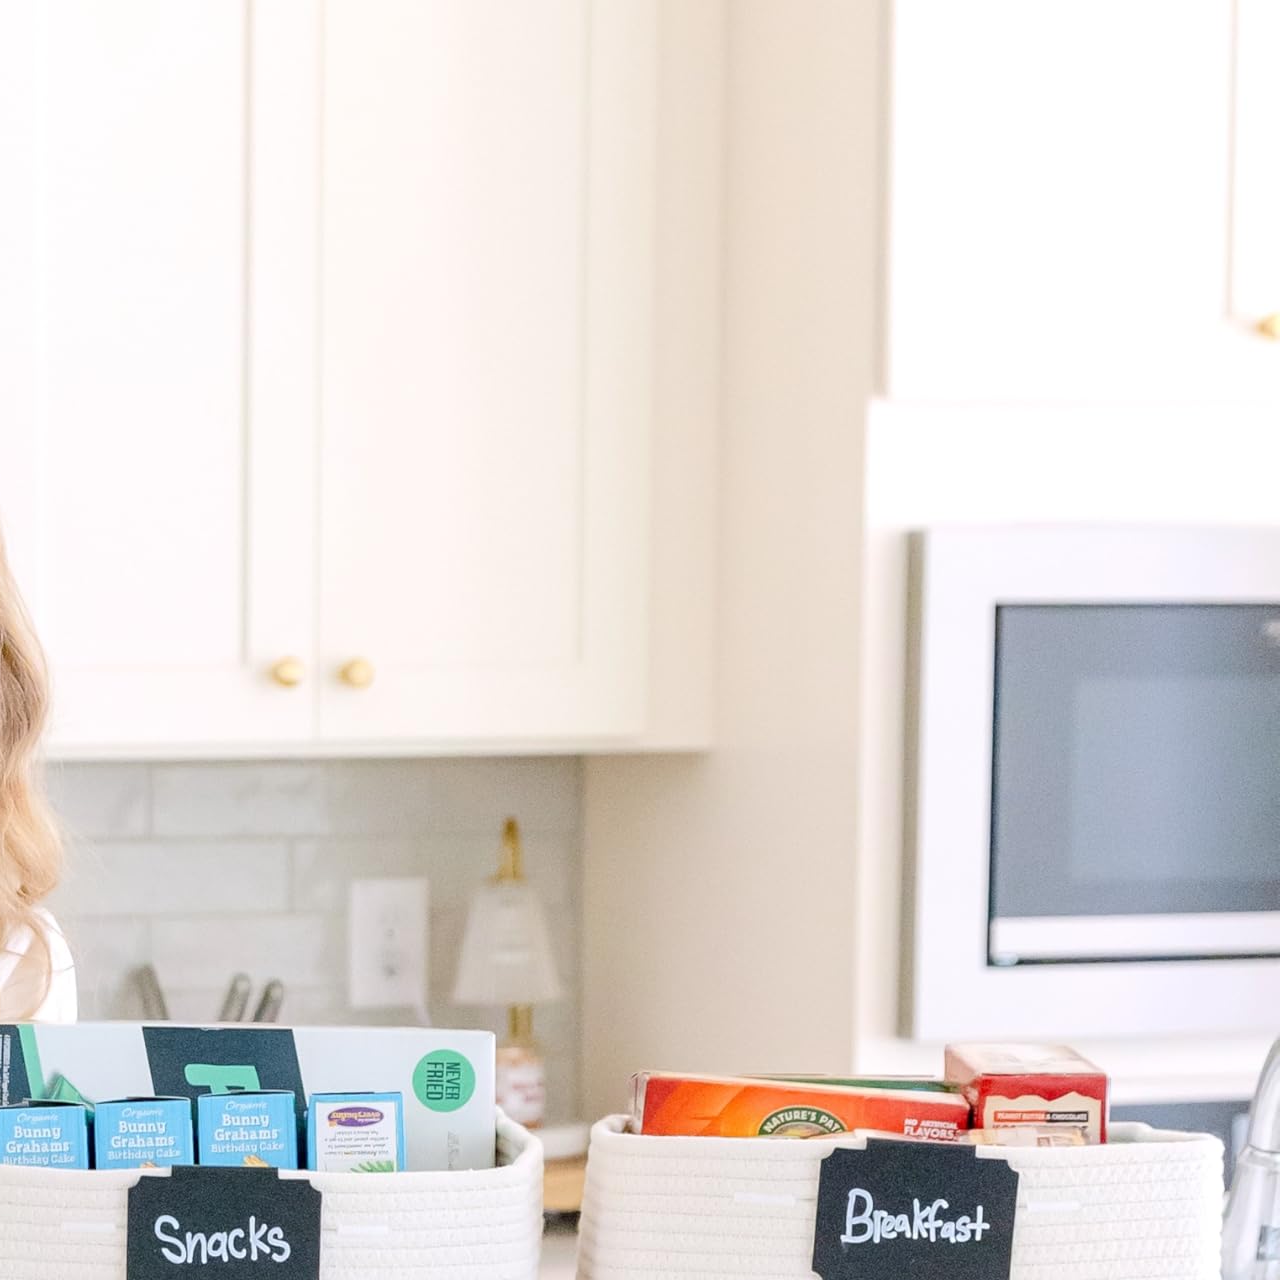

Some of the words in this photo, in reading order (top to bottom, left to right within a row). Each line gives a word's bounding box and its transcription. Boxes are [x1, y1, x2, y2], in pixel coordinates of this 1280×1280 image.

[426, 1062, 444, 1101] FRIED
[445, 1062, 461, 1100] NEVER
[225, 1101, 267, 1111] Organic
[222, 1114, 269, 1127] Bunny
[763, 1110, 816, 1133] NATURE'S
[14, 1126, 61, 1139] Bunny
[119, 1121, 166, 1134] Bunny
[214, 1129, 278, 1141] Grahams
[6, 1141, 70, 1153] Grahams
[111, 1136, 175, 1148] Grahams
[211, 1142, 258, 1153] Birthday
[260, 1141, 285, 1151] Cake
[3, 1155, 48, 1165] Birthday
[50, 1154, 76, 1164] Cake
[107, 1149, 155, 1161] Birthday
[156, 1148, 181, 1158] Cake
[840, 1187, 990, 1244] Breakfast
[154, 1215, 291, 1264] Snacks
